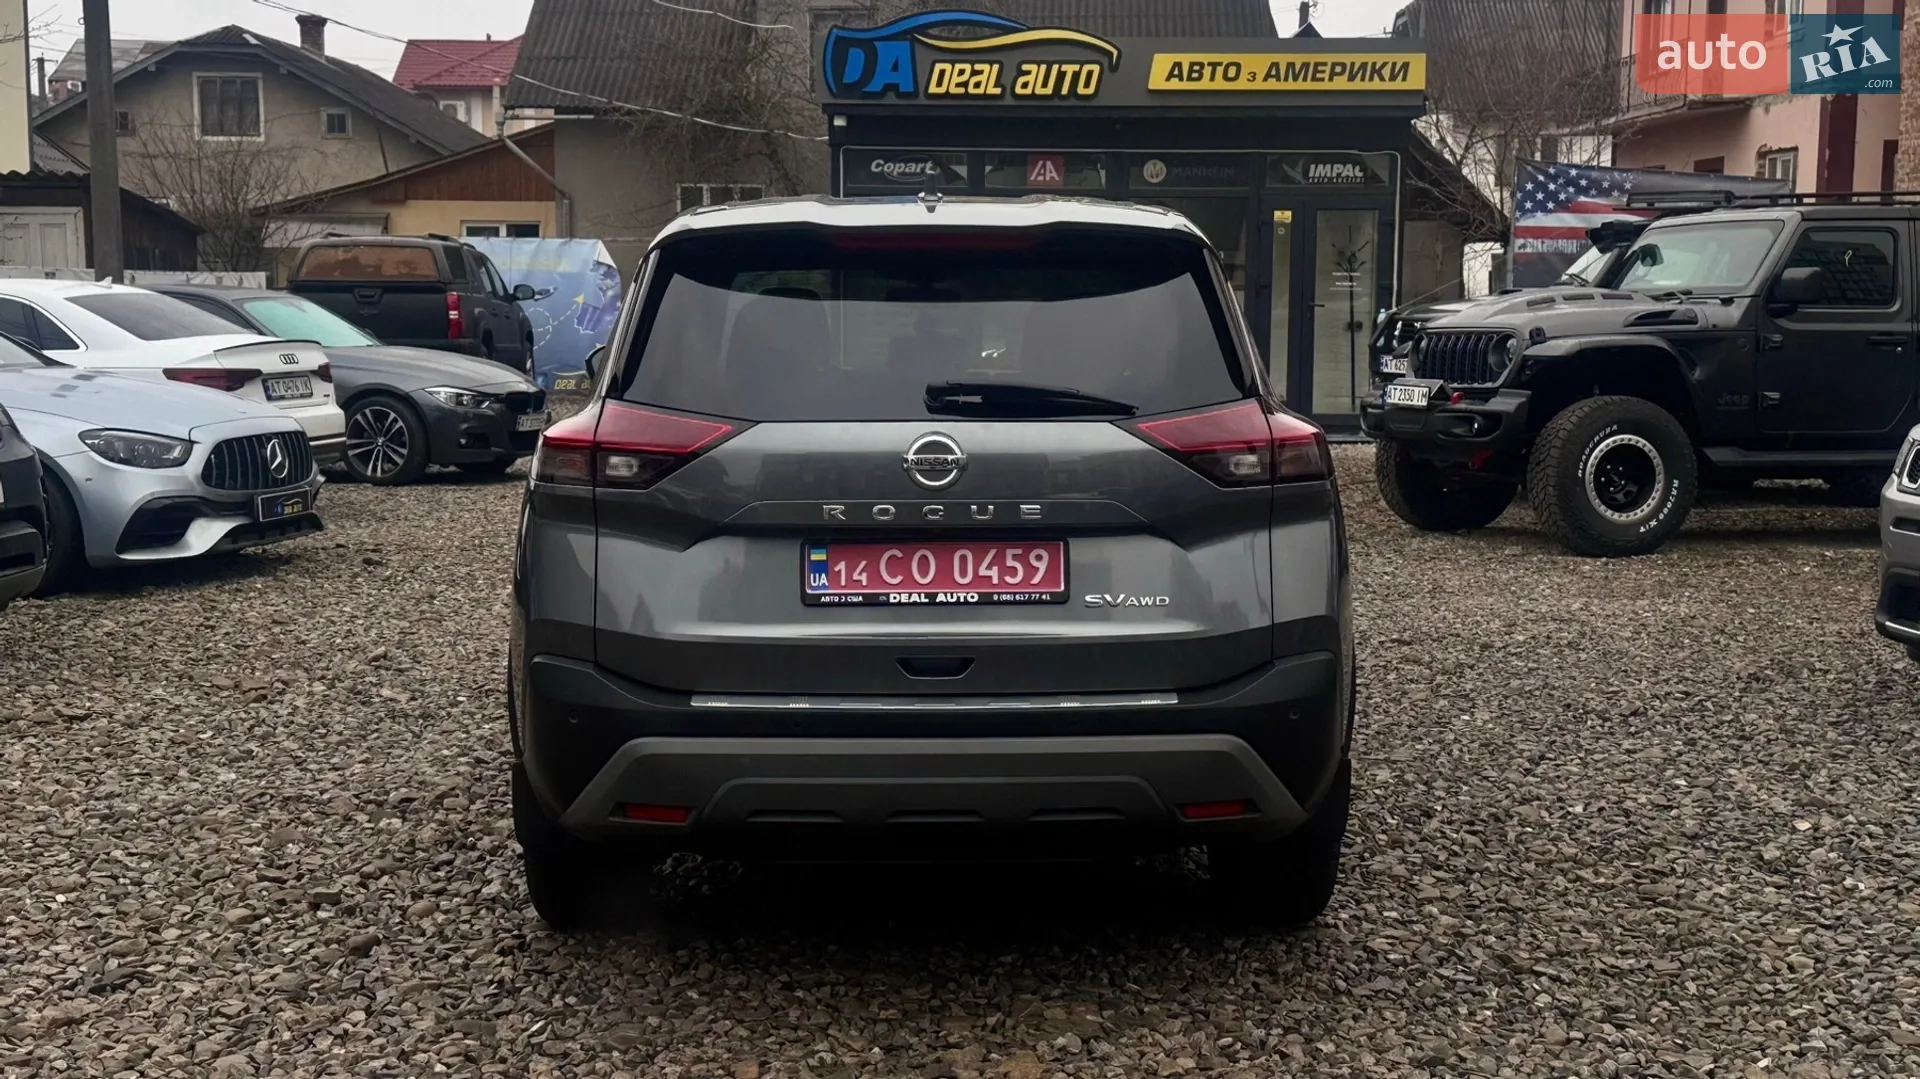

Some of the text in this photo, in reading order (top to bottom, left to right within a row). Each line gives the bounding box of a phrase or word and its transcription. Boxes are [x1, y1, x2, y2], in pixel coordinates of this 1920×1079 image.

[834, 39, 915, 93] DA
[1165, 61, 1242, 83] АВТО
[1262, 61, 1411, 83] АМЕРИКИ
[870, 159, 934, 179] Copart
[271, 379, 282, 395] AT
[1387, 386, 1398, 401] AT
[1416, 389, 1428, 403] IM
[909, 458, 961, 467] NISSAN
[822, 504, 1043, 520] ROGUE
[833, 548, 1049, 587] 14 CO 0459
[810, 573, 828, 586] UA
[889, 592, 979, 603] DEAL AUTO
[1084, 594, 1170, 608] SV AWD
